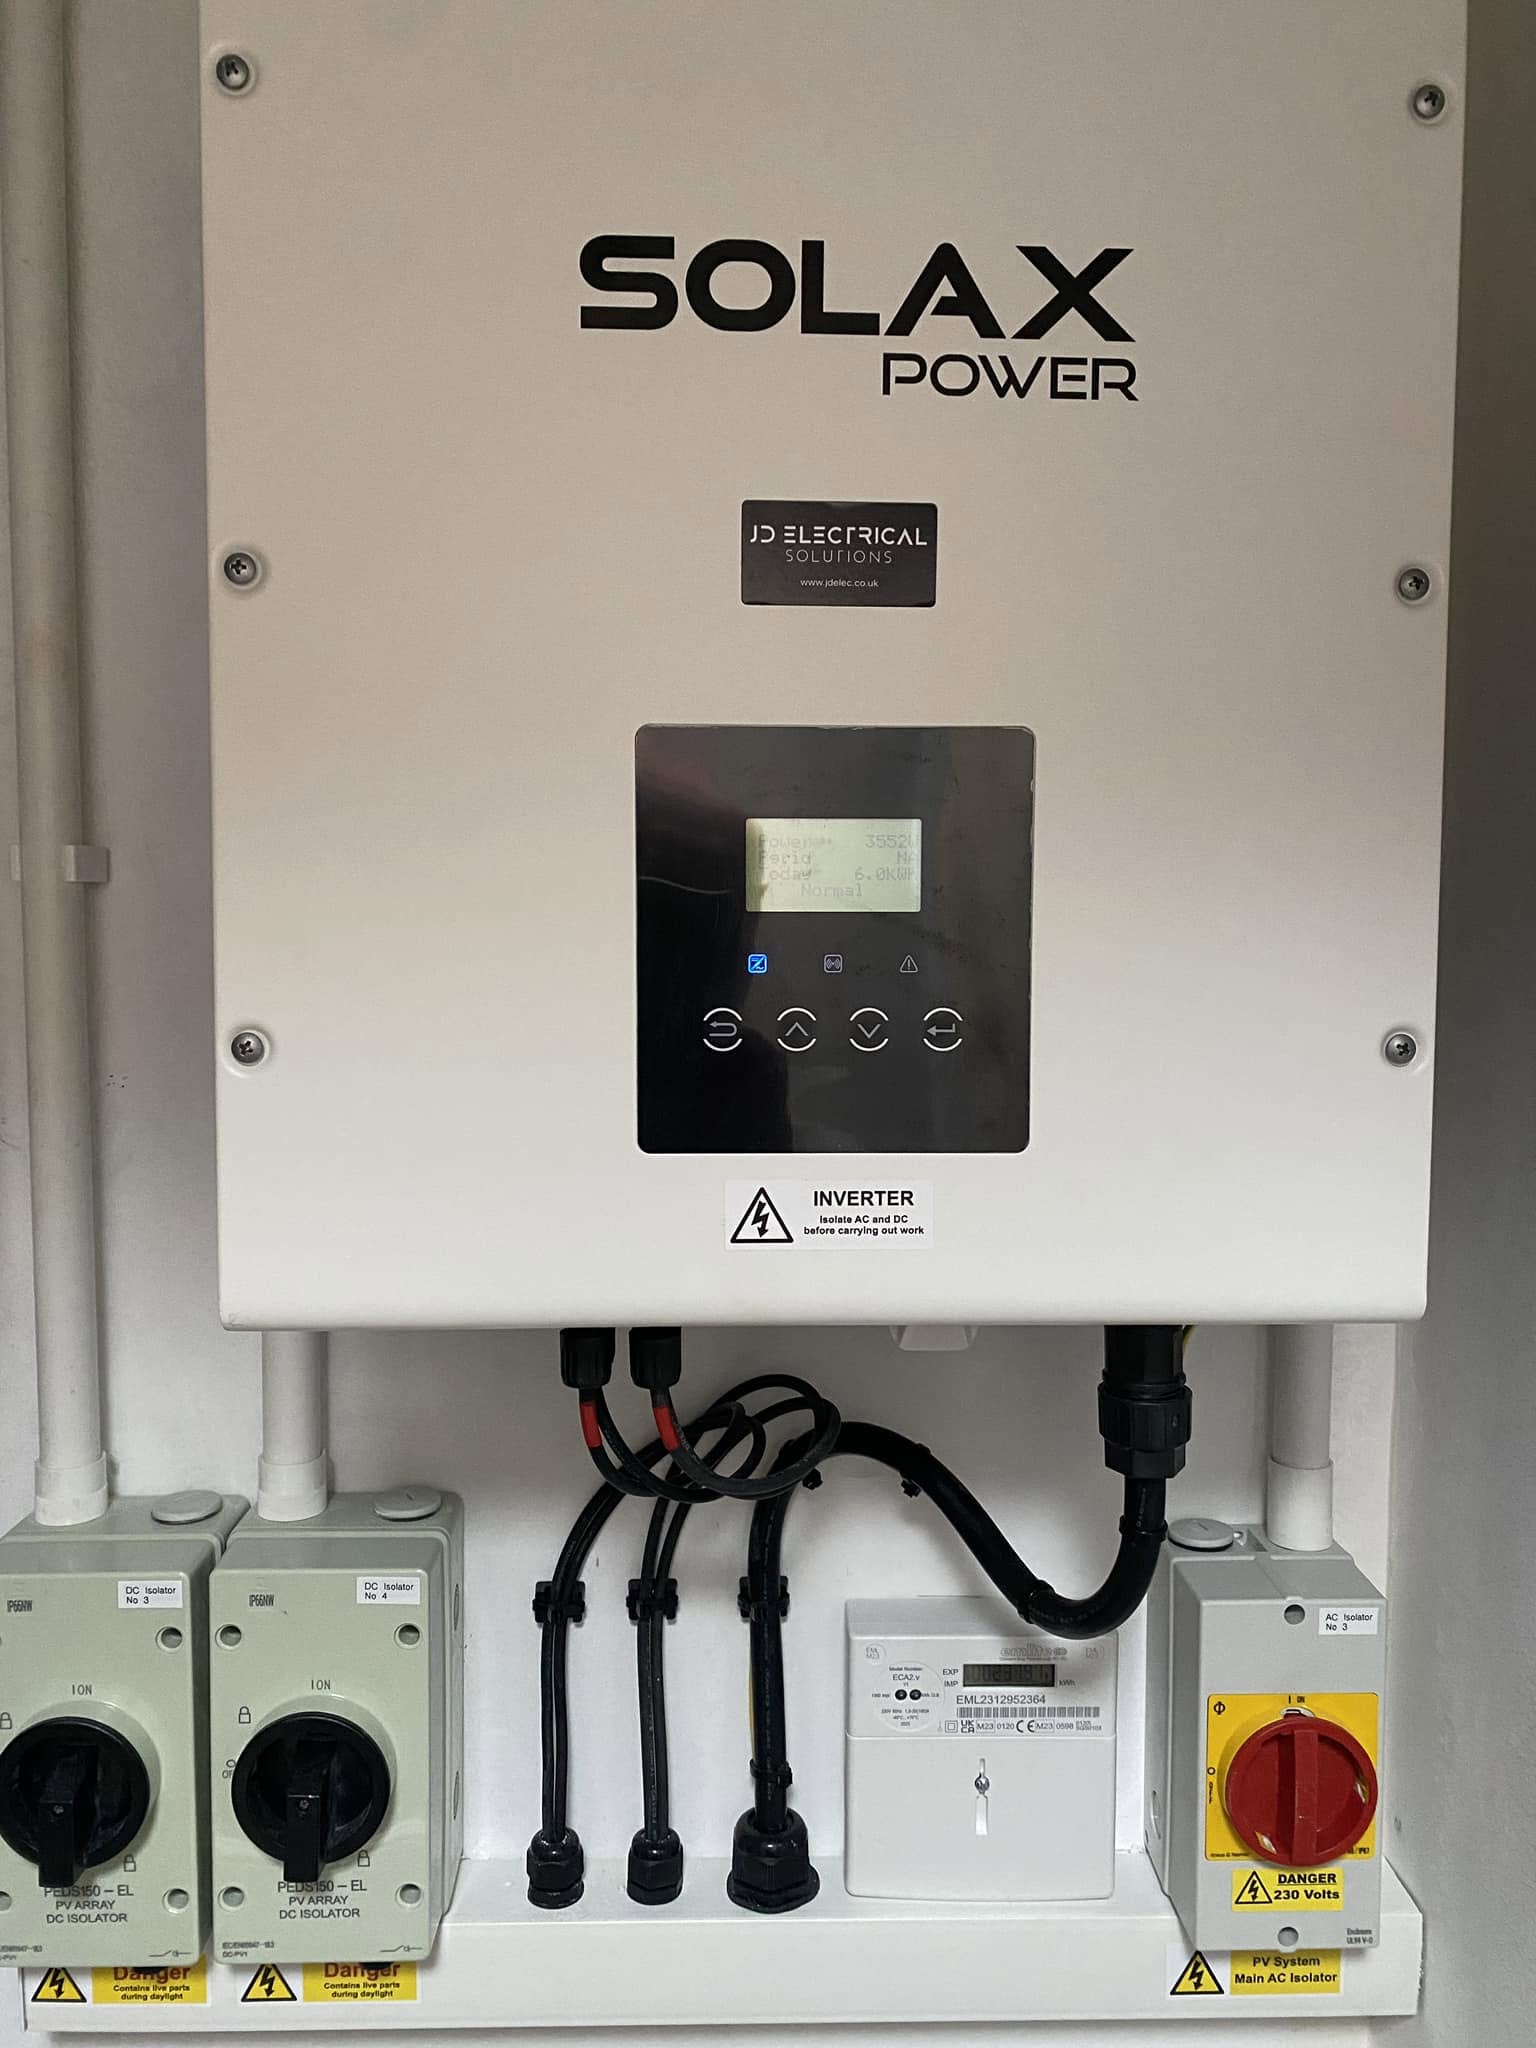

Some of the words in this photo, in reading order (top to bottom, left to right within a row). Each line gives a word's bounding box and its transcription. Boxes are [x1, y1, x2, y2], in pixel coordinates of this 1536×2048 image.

[579, 234, 1136, 342] SOLAX
[882, 352, 1139, 401] POWER
[750, 525, 776, 543] JD
[784, 525, 927, 546] ELECTRICAL
[786, 549, 893, 564] SOLUTIONS
[800, 578, 879, 588] www.jdelec.co.uk
[800, 884, 863, 897] Normal
[813, 1190, 914, 1206] INVERTER
[820, 1215, 852, 1224] Isolate
[854, 1215, 870, 1224] AC
[872, 1215, 890, 1224] and
[893, 1215, 908, 1224] DC
[804, 1226, 835, 1235] before
[838, 1226, 878, 1237] carrying
[881, 1227, 898, 1235] out
[900, 1226, 924, 1235] work
[125, 1586, 140, 1595] DC
[145, 1586, 176, 1595] Isolator
[364, 1582, 378, 1591] DC
[383, 1582, 414, 1591] Isolator
[126, 1597, 138, 1605] No
[364, 1592, 377, 1600] No
[382, 1592, 387, 1600] 4
[1325, 1613, 1338, 1622] AC
[1343, 1613, 1373, 1622] Isolator
[1325, 1623, 1337, 1631] No
[1342, 1623, 1348, 1631] 3
[942, 1668, 959, 1676] EXP
[956, 1694, 1046, 1705] EML2312952364
[977, 1722, 994, 1730] M23
[996, 1722, 1015, 1730] 0120
[1036, 1722, 1053, 1730] M23
[1277, 1873, 1337, 1884] DANGER
[117, 1884, 134, 1897] EL
[277, 1880, 334, 1893] PEDS150
[351, 1880, 367, 1892] EL
[1274, 1890, 1299, 1900] 230
[1304, 1889, 1340, 1900] Volts
[56, 1900, 72, 1910] PV
[74, 1900, 116, 1910] ARRAY
[289, 1896, 305, 1905] PV
[307, 1895, 349, 1905] ARRAY
[46, 1914, 64, 1924] DC
[67, 1913, 128, 1923] ISOLATOR
[279, 1910, 297, 1919] DC
[300, 1908, 361, 1919] ISOLATOR
[1252, 1957, 1270, 1967] PV
[1274, 1956, 1320, 1969] System
[1234, 1973, 1264, 1984] Main
[1267, 1973, 1286, 1983] AC
[1290, 1972, 1337, 1983] Isolator
[152, 1984, 167, 1992] live
[169, 1985, 190, 1994] parts
[323, 1982, 360, 1990] Contains
[362, 1981, 377, 1989] live
[379, 1982, 400, 1991] parts
[121, 1993, 148, 2002] during
[150, 1993, 183, 2002] daylight
[331, 1991, 358, 1999] during
[360, 1990, 393, 1999] daylight
